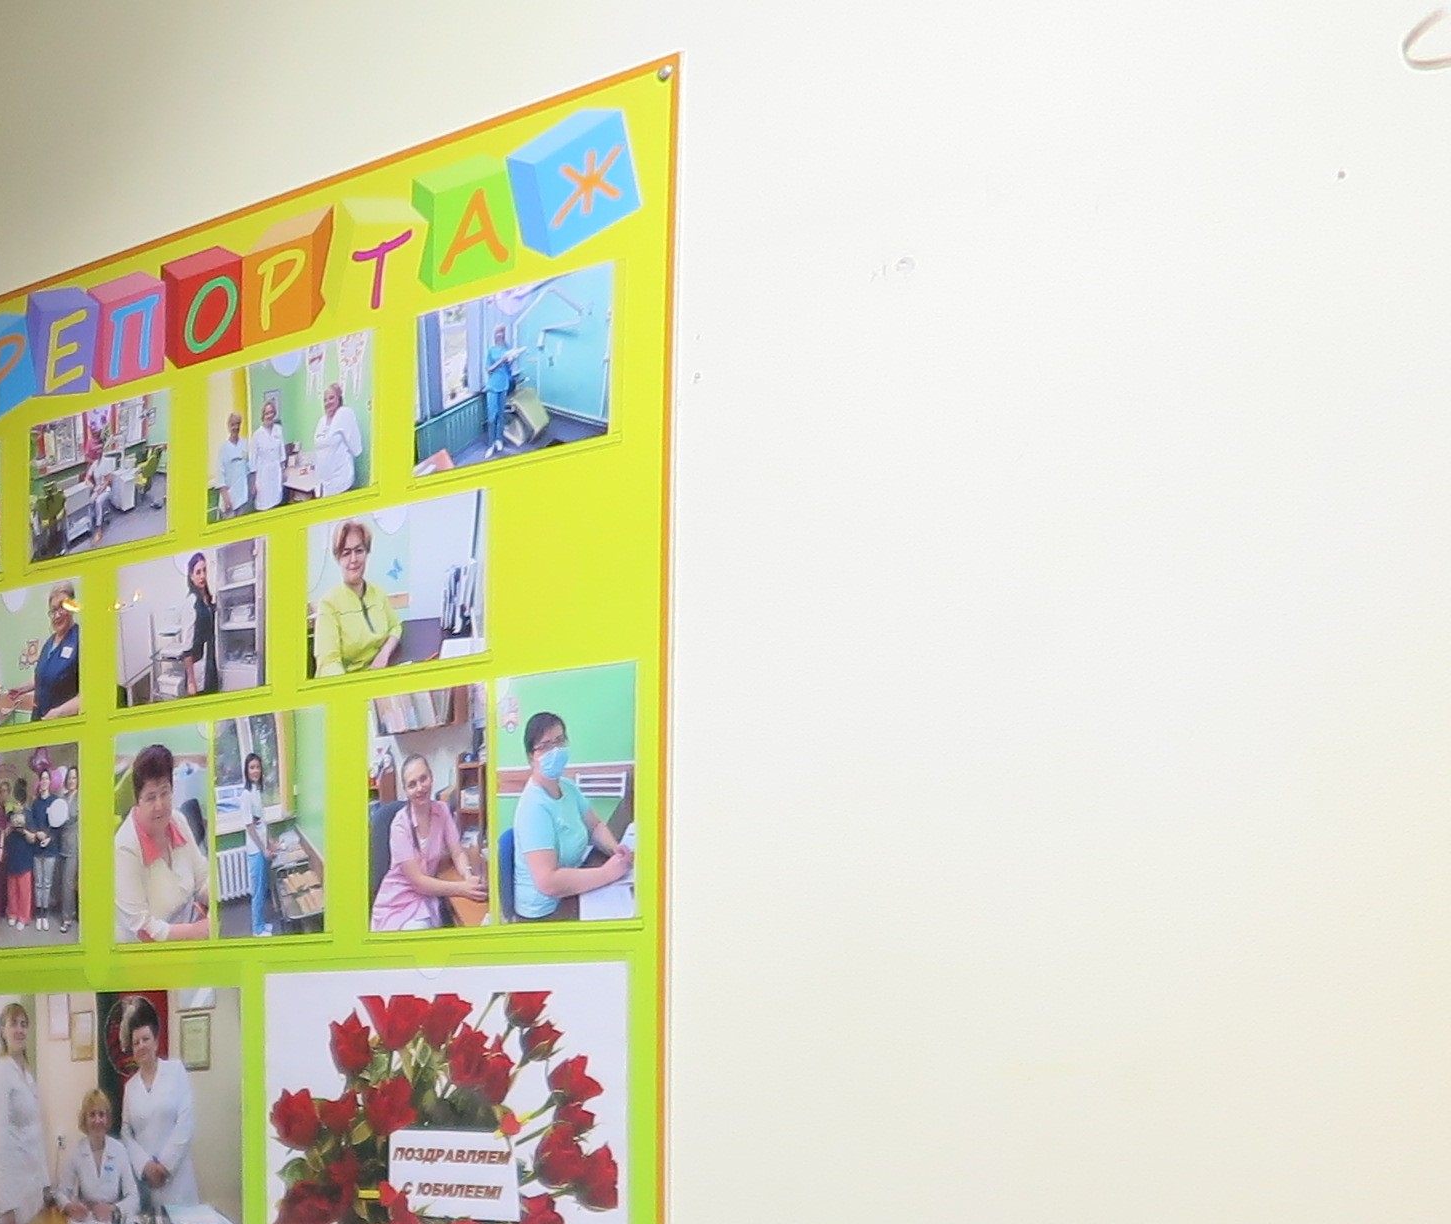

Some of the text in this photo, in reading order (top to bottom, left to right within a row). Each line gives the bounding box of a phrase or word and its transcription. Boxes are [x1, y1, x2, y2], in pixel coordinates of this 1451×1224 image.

[392, 1147, 512, 1165] ПОЗДРАВЛЯЕМ
[402, 1182, 503, 1200] С ЮБИЛЕЕМ!
